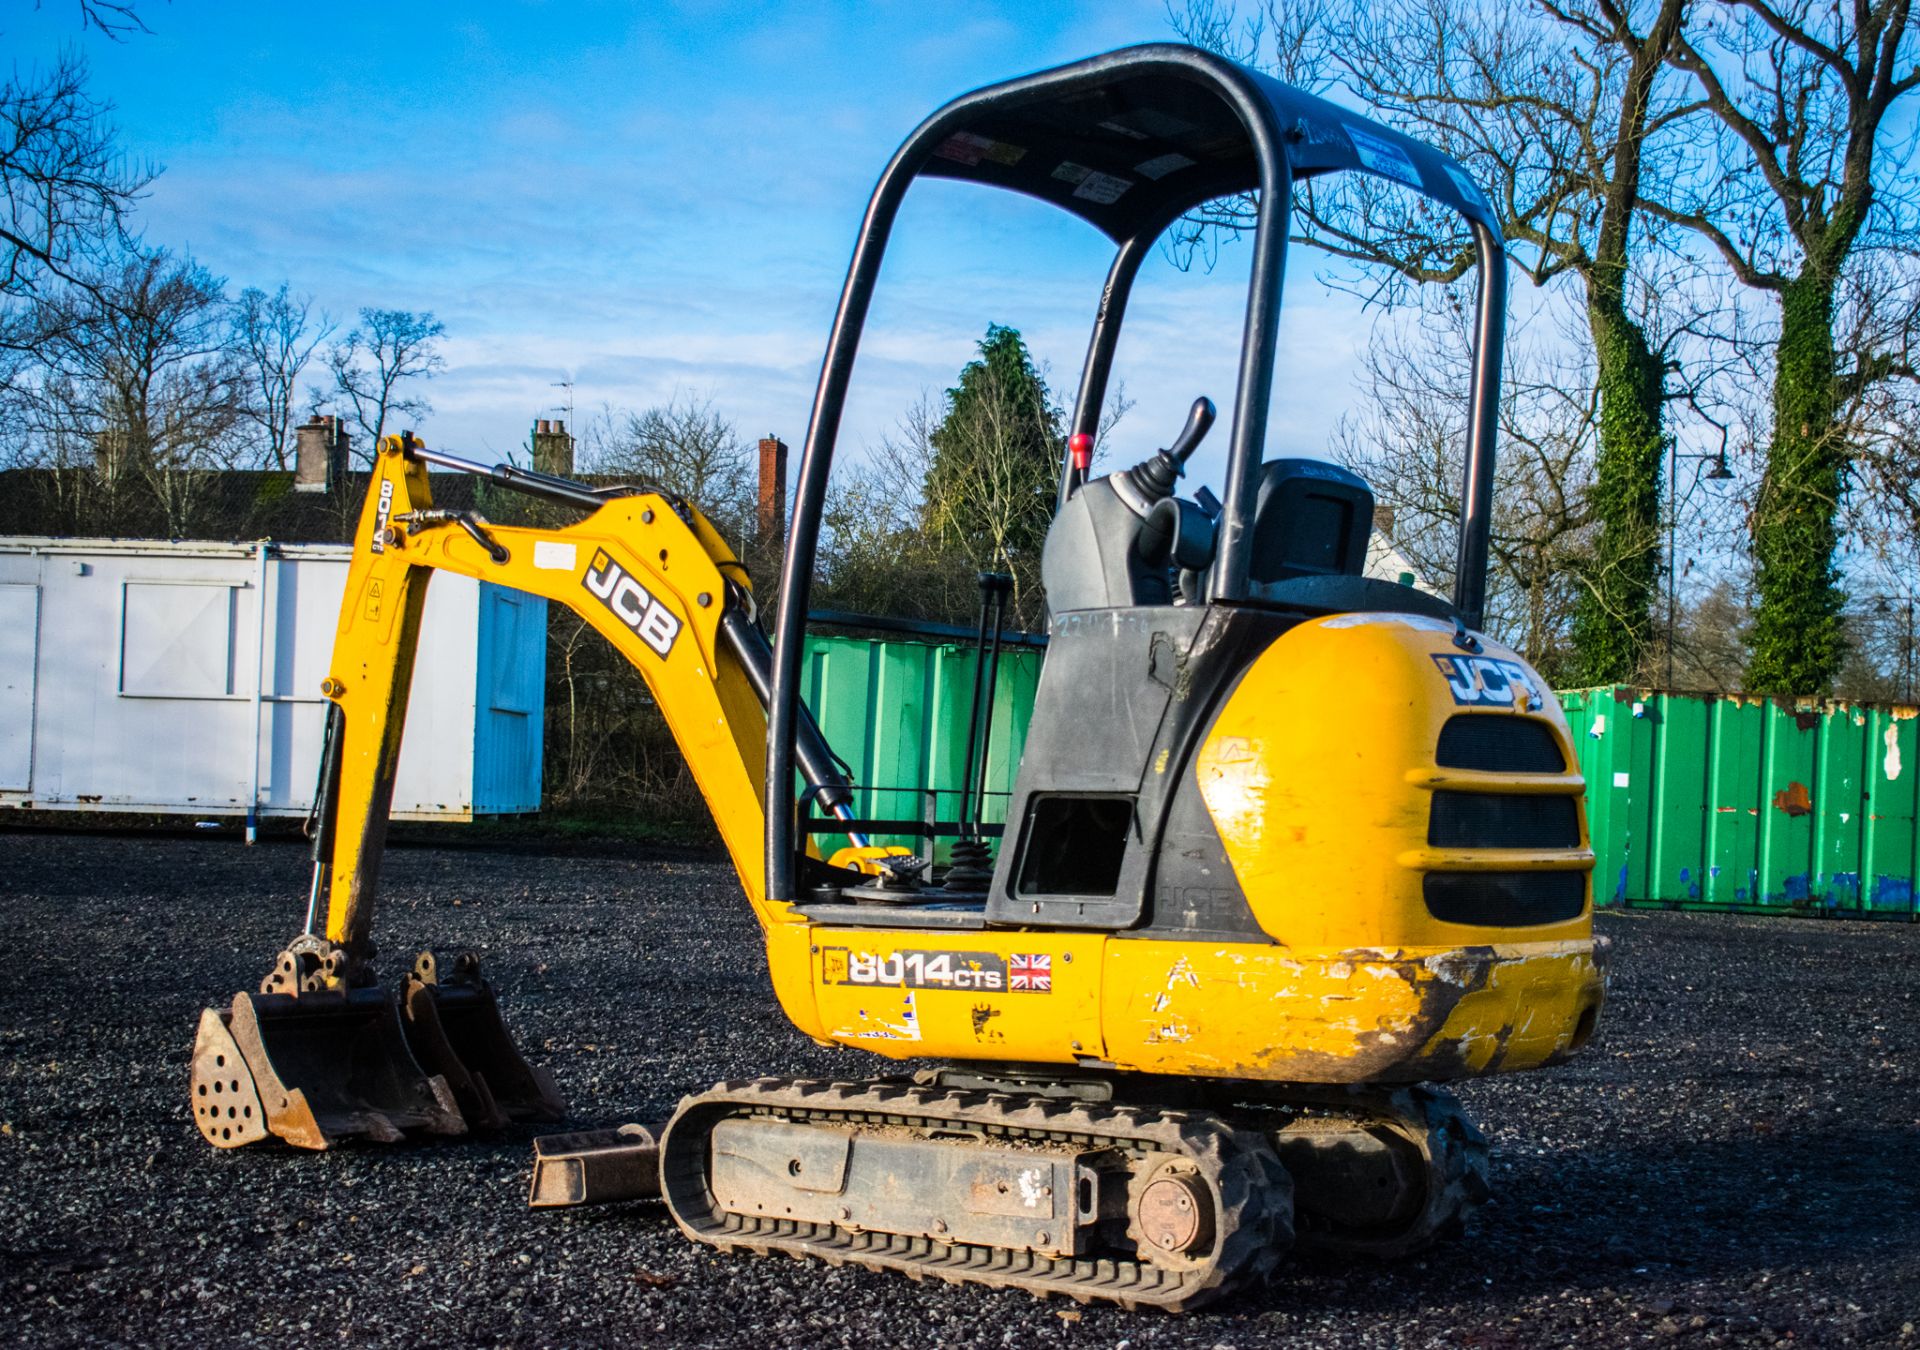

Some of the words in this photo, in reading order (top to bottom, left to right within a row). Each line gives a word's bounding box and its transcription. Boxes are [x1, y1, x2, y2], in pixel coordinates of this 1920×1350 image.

[373, 480, 394, 546] 8014
[586, 564, 679, 655] JCB
[849, 951, 953, 986] 8014
[953, 970, 1002, 989] CTS
